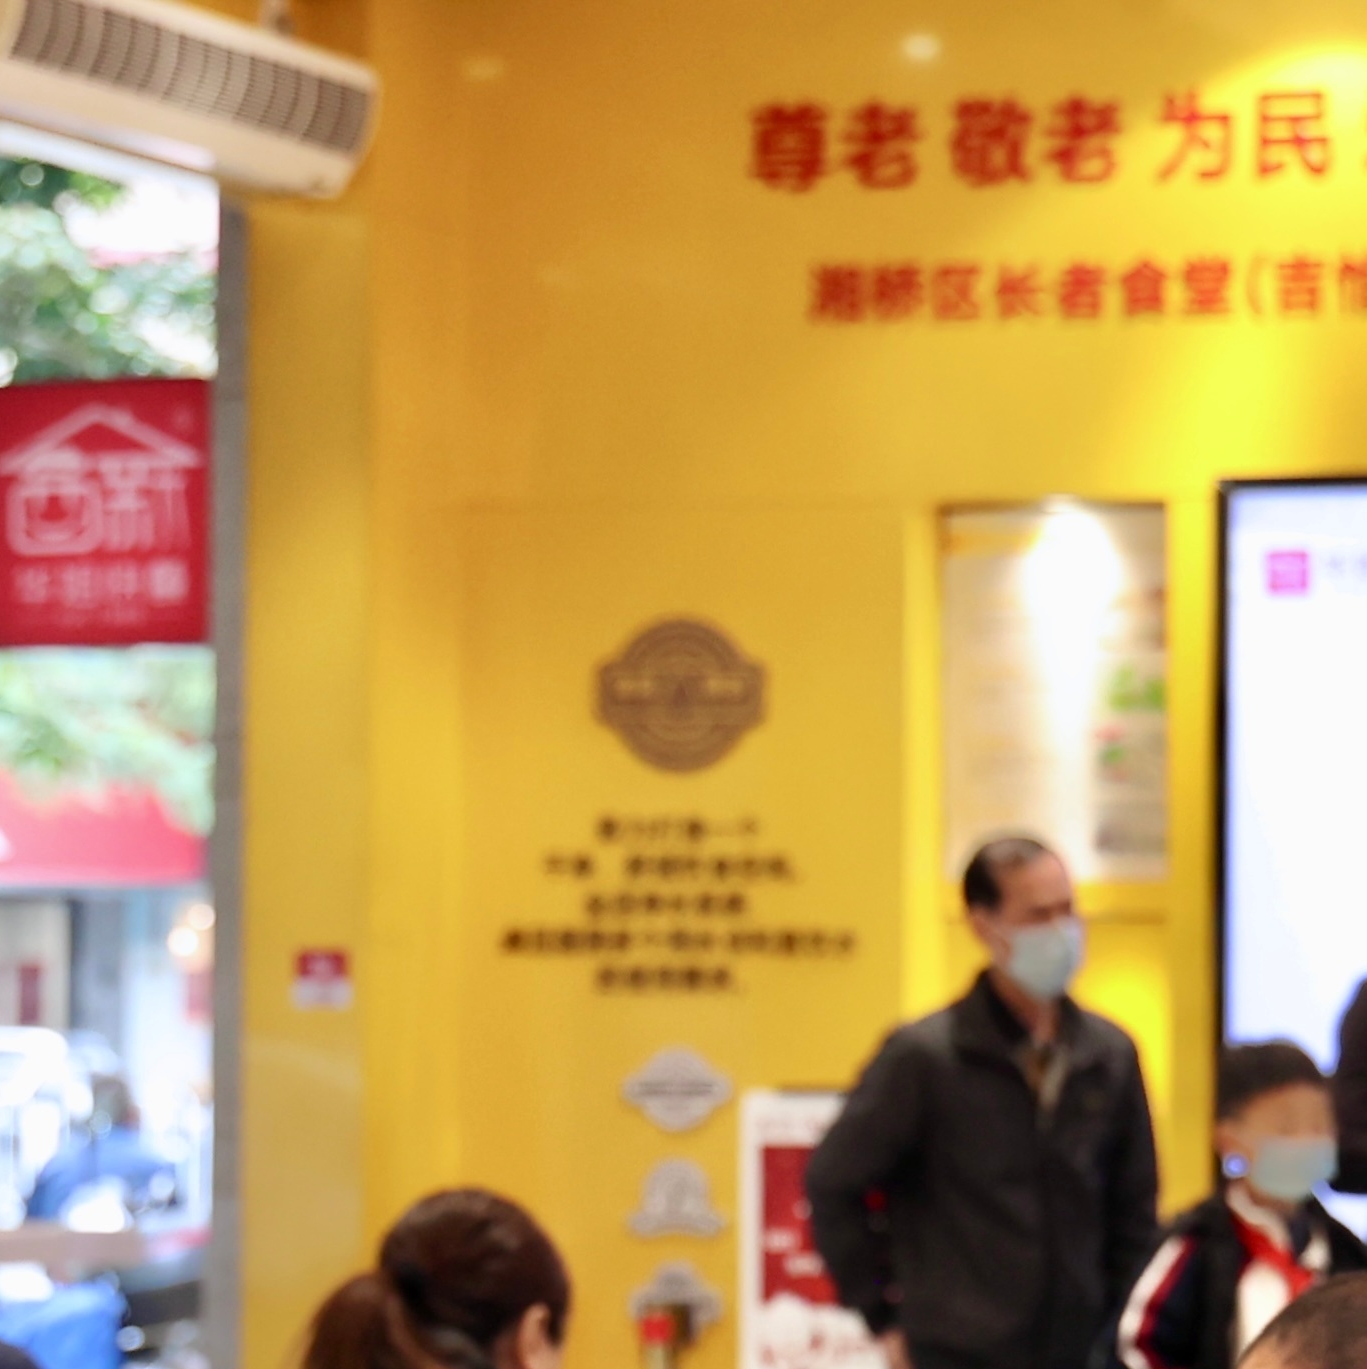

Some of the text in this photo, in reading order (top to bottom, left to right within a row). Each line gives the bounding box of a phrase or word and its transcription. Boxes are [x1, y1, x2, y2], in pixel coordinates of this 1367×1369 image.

[749, 100, 922, 191] 尊老
[949, 94, 1121, 188] 敬老
[1158, 91, 1330, 184] 为民
